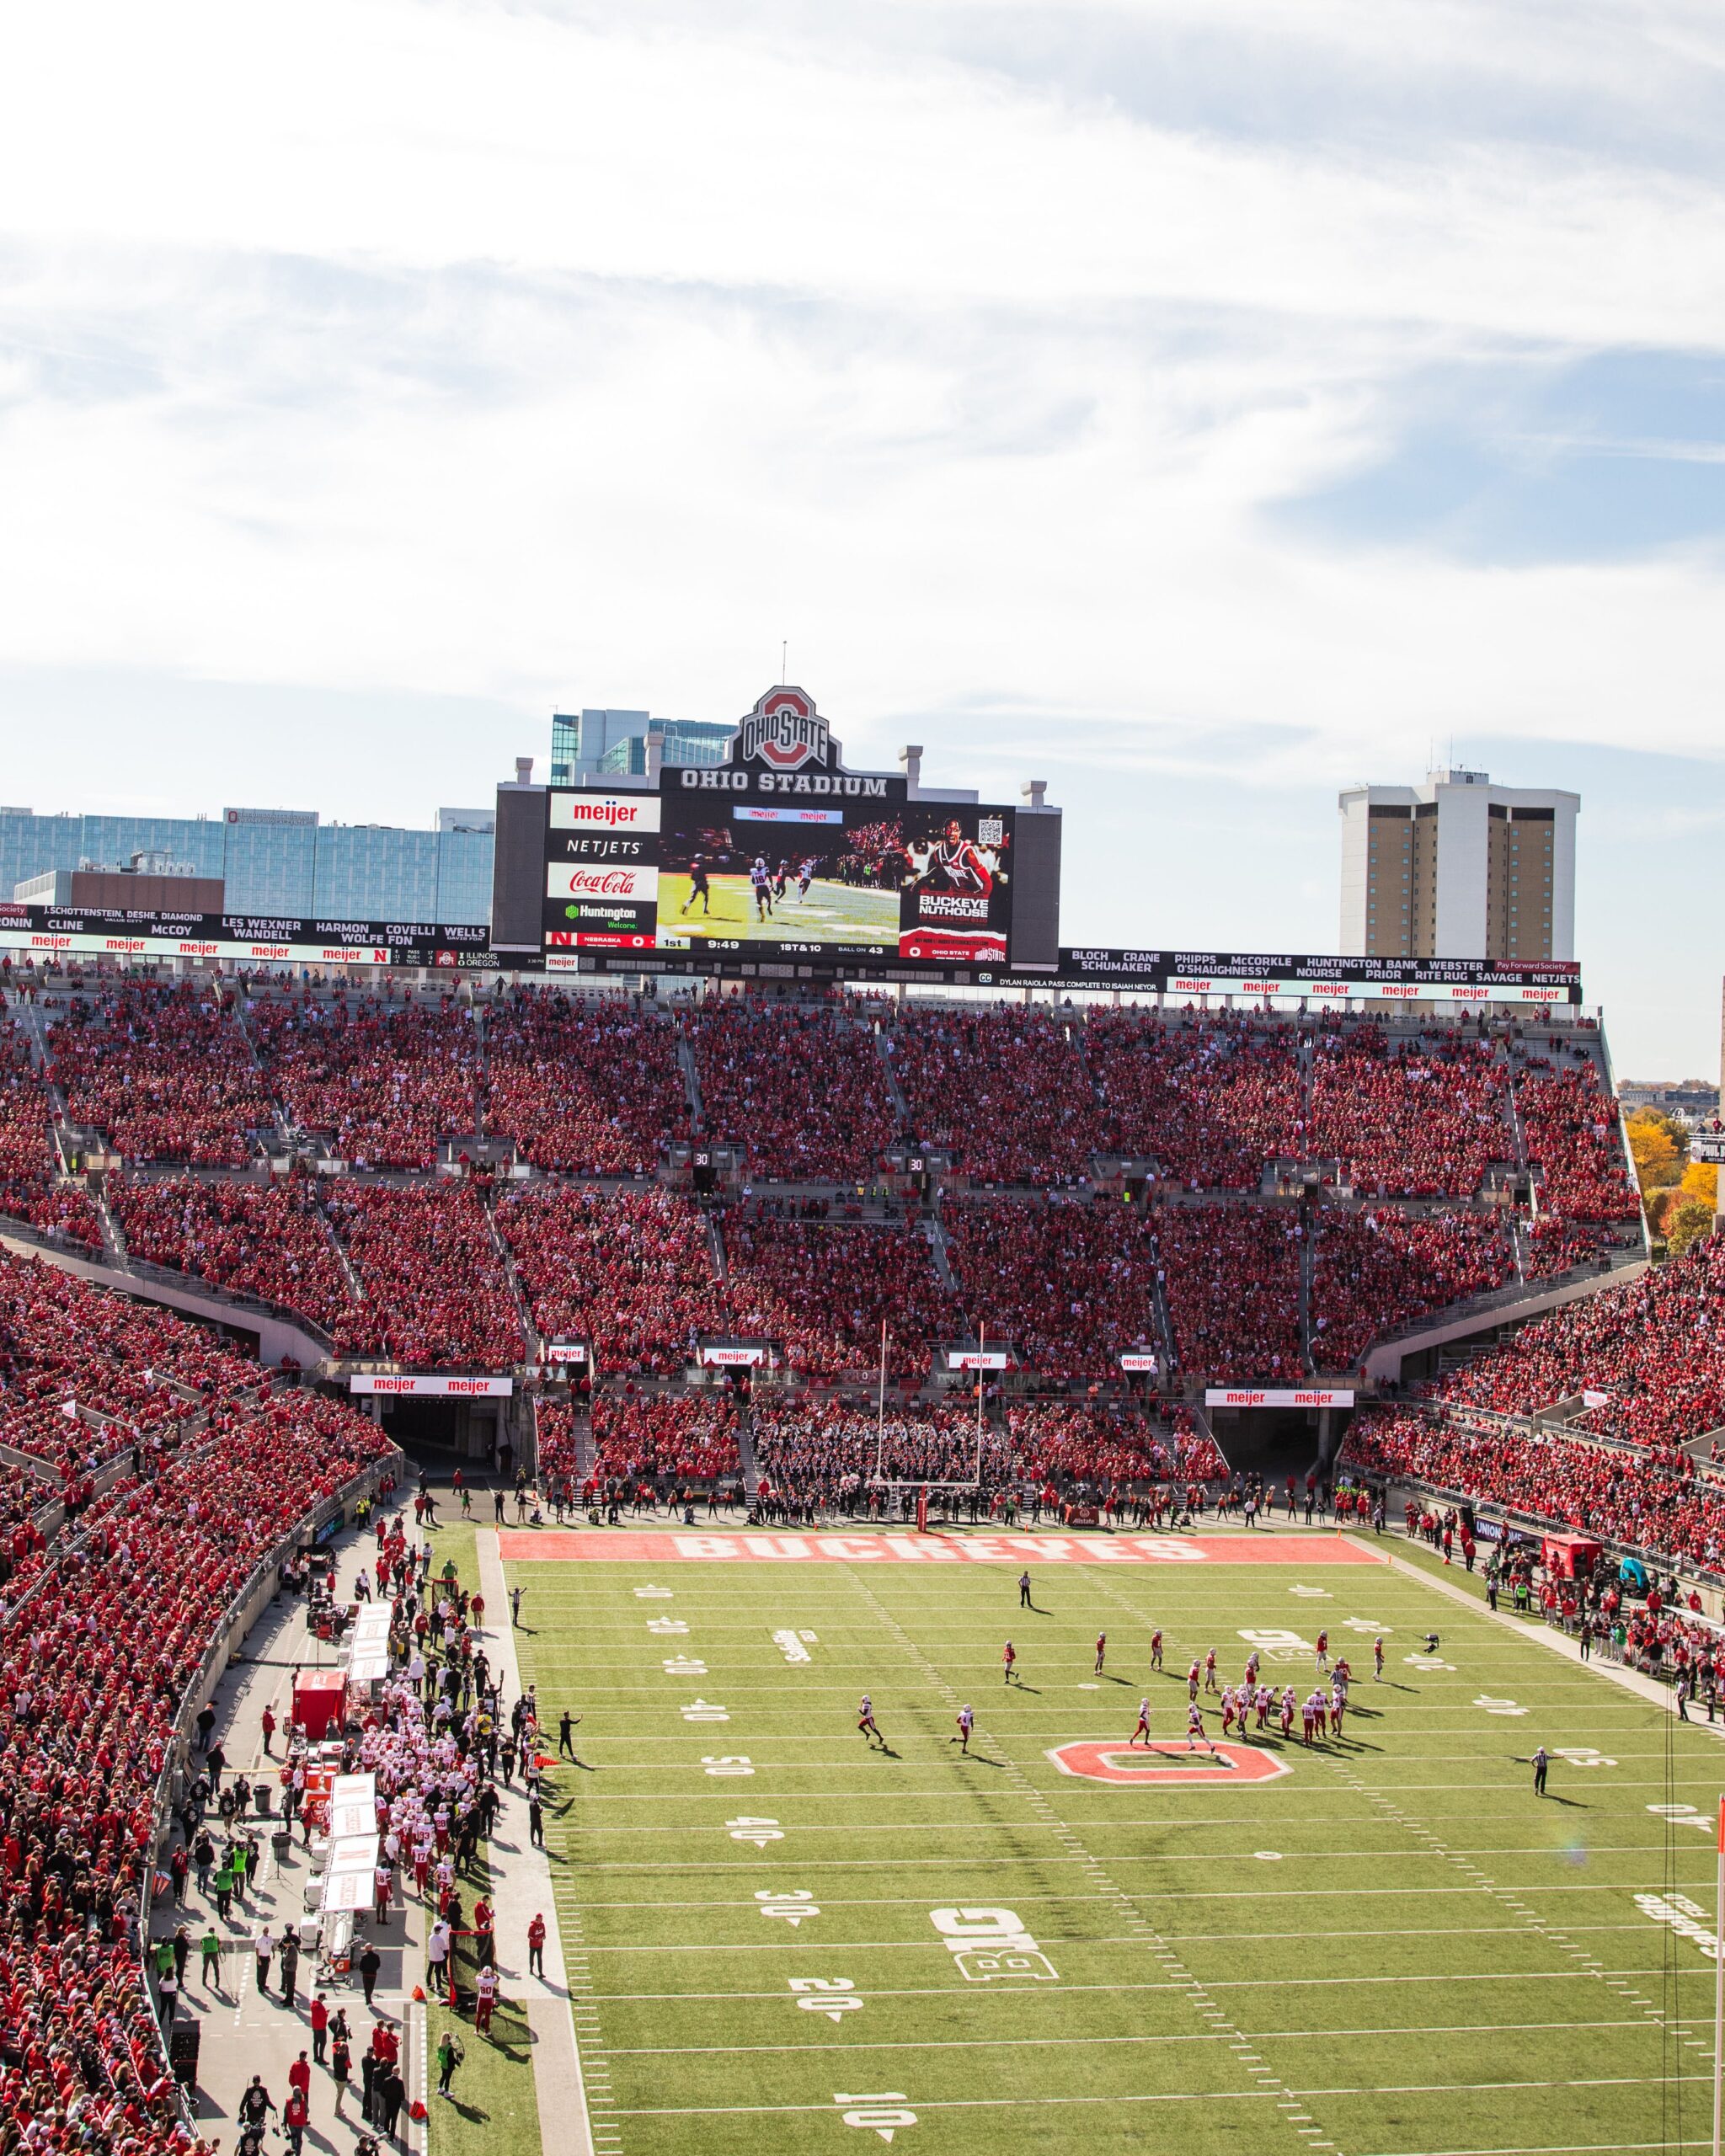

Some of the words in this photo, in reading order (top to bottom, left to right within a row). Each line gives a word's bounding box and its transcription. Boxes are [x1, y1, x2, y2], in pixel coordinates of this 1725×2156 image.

[681, 769, 748, 791] OHIO
[758, 772, 887, 798] STADIUM
[574, 801, 638, 825] meijer
[567, 840, 640, 857] NETJETS
[569, 870, 637, 894] Coca-Cola
[919, 894, 990, 910] BUCKEYE
[0, 905, 25, 915] ociety
[126, 910, 158, 921] DESHE,
[161, 912, 203, 922] DIAMOND
[579, 905, 637, 921] Huntington
[919, 905, 989, 918] NUTHOUSE
[0, 917, 33, 928] ONIN
[47, 920, 84, 931] CLINE
[222, 917, 243, 927] LES
[248, 918, 302, 931] WEXNER
[316, 922, 369, 934] HARMON
[152, 924, 192, 936] McCOY
[233, 928, 291, 940] WANDELL
[386, 925, 435, 936] COVELLI
[445, 926, 486, 938] WELLS
[32, 934, 72, 951] meijer
[106, 937, 146, 953] meijer
[341, 933, 384, 944] WOLFE
[388, 935, 413, 945] FDN
[664, 939, 681, 948] 1st
[708, 940, 740, 949] 9:49
[179, 941, 218, 956] meijer
[252, 944, 290, 959] meijer
[780, 943, 799, 953] 1ST
[799, 943, 809, 953] &
[809, 944, 822, 953] 10
[868, 946, 884, 955] 43
[323, 947, 362, 962] meijer
[374, 950, 387, 963] N
[467, 952, 498, 960] ILLINOIS
[1072, 950, 1108, 961] BLOCH
[1123, 952, 1161, 963] CRANE
[1174, 954, 1216, 964] PHIPPS
[548, 956, 575, 967] meijer
[1081, 961, 1151, 973] SCHUMAKER
[1231, 956, 1292, 967] McCORKLE
[1307, 958, 1381, 969] HUNTINGTON
[1386, 960, 1418, 969] BANK
[1429, 961, 1483, 971] WEBSTER
[1497, 962, 1509, 970] Pay
[1177, 964, 1269, 976] O'SHAUGHNESSY
[1296, 968, 1342, 978] NOURSE
[1365, 969, 1402, 979] PRIOR
[1415, 970, 1441, 980] RITE
[1444, 971, 1468, 981] RUG
[1000, 978, 1022, 986] DYLAN
[1066, 981, 1101, 990] COMPLETE
[1476, 973, 1523, 983] SAVAGE
[1532, 974, 1580, 985] NETJETS
[1176, 979, 1211, 992] meijer
[1243, 980, 1280, 995] meijer
[1312, 982, 1349, 996] meijer
[1382, 984, 1419, 998] meijer
[1452, 985, 1489, 1000] meijer
[1522, 987, 1560, 1001] meijer
[697, 1154, 708, 1166] 30
[911, 1160, 922, 1171] 30
[718, 1350, 749, 1363] meijer
[1123, 1357, 1152, 1369] meijer
[373, 1376, 416, 1393] meijer
[448, 1378, 490, 1394] meijer
[1226, 1390, 1265, 1406] meijer
[1295, 1390, 1333, 1406] meijer
[1477, 1521, 1503, 1540] UNION
[673, 1535, 1208, 1561] BUCKEYES
[1552, 1748, 1619, 1766] 50
[701, 1756, 756, 1775] 50
[316, 1800, 325, 1808] G
[437, 1819, 446, 1828] 28
[724, 1816, 785, 1840] 40
[417, 1853, 425, 1861] 17
[377, 1875, 385, 1883] 18
[440, 1871, 447, 1880] 13
[754, 1889, 820, 1918] 30
[788, 1977, 864, 2011] 20
[833, 2091, 918, 2127] 10
